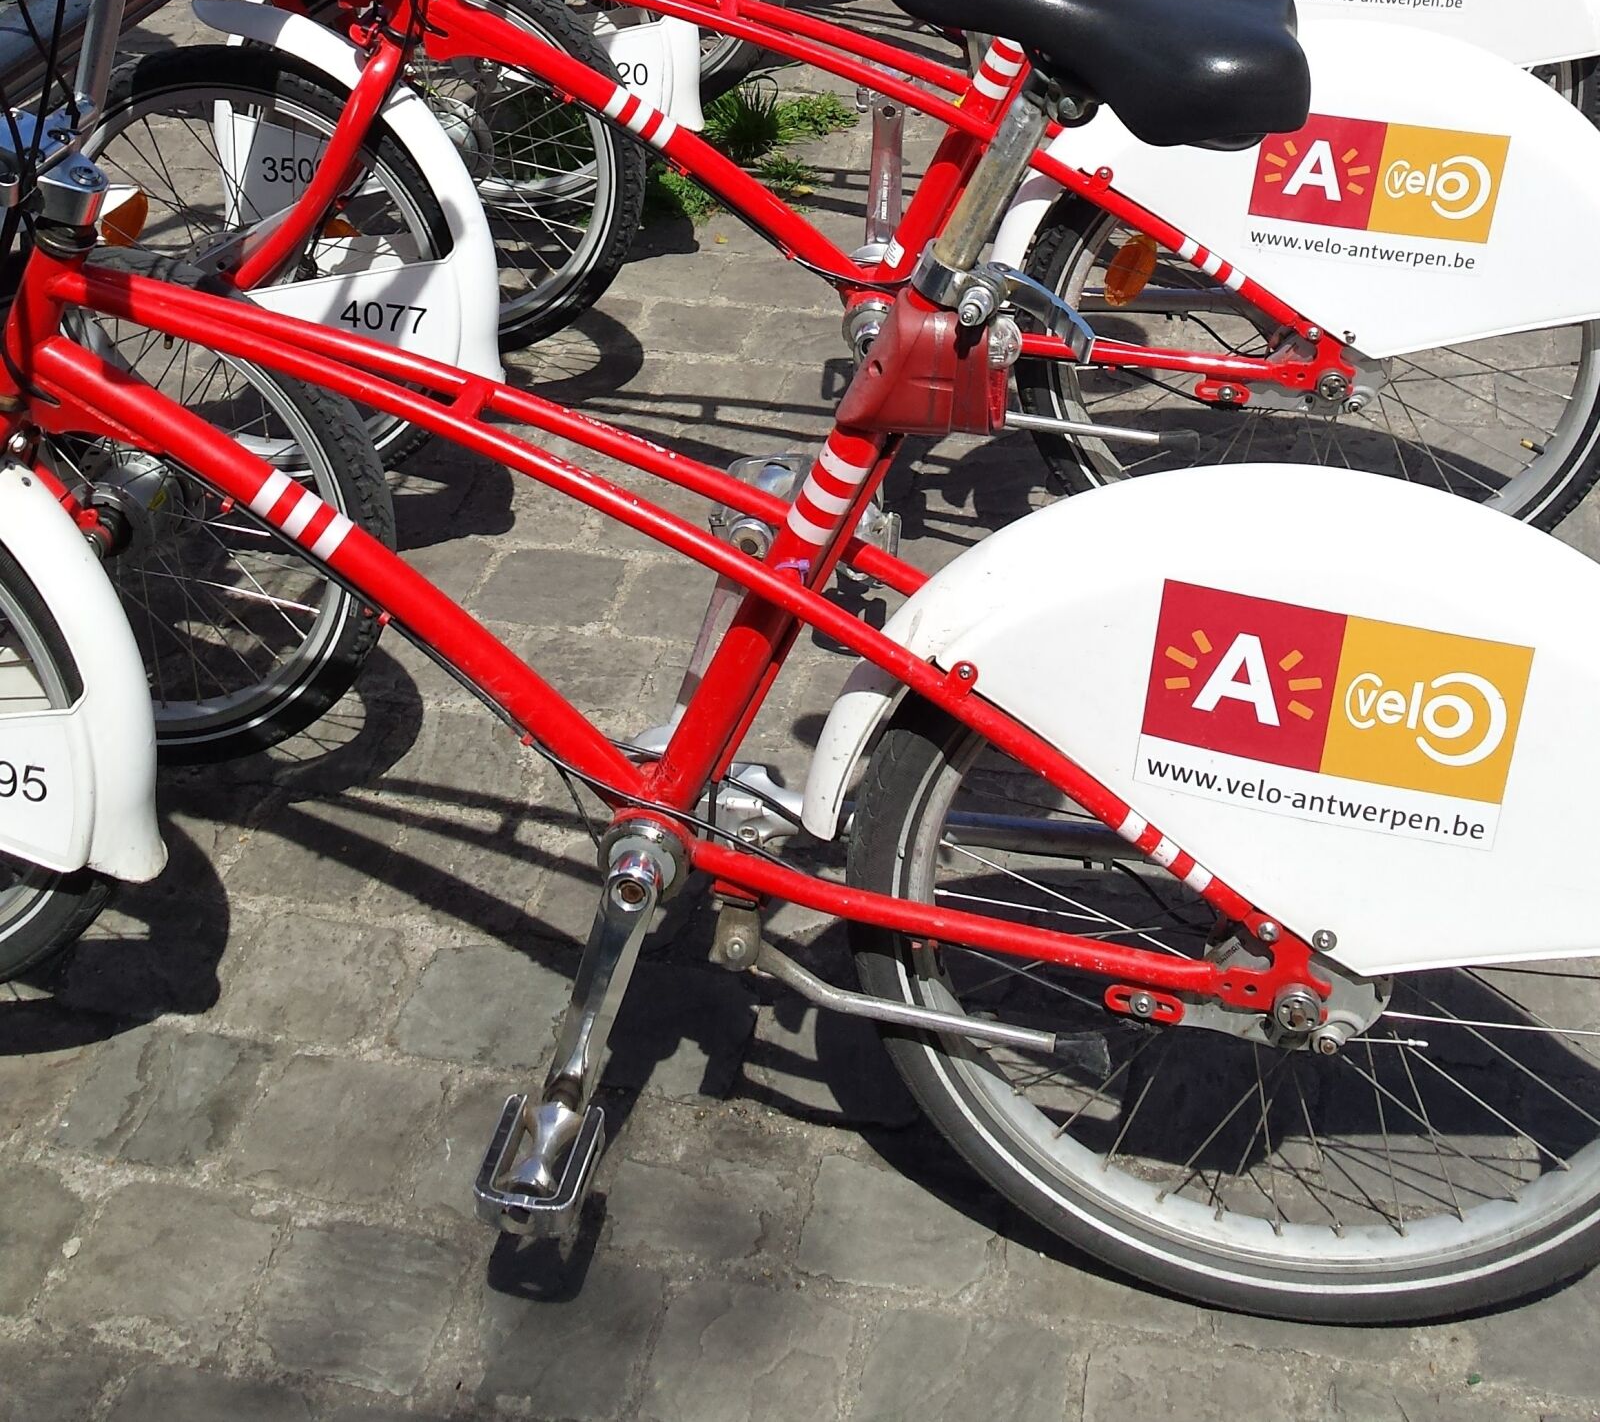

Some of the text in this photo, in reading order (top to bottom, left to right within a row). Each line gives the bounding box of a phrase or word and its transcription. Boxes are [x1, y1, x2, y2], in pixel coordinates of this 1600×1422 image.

[616, 62, 648, 86] 20
[262, 157, 322, 184] 350
[1281, 139, 1342, 202] A
[1250, 230, 1475, 270] www.velo-antwerpen.be
[340, 300, 428, 334] 4077
[1191, 632, 1280, 727] A
[0, 760, 48, 803] 95
[1147, 757, 1486, 841] www.velo-antwerpen.be
